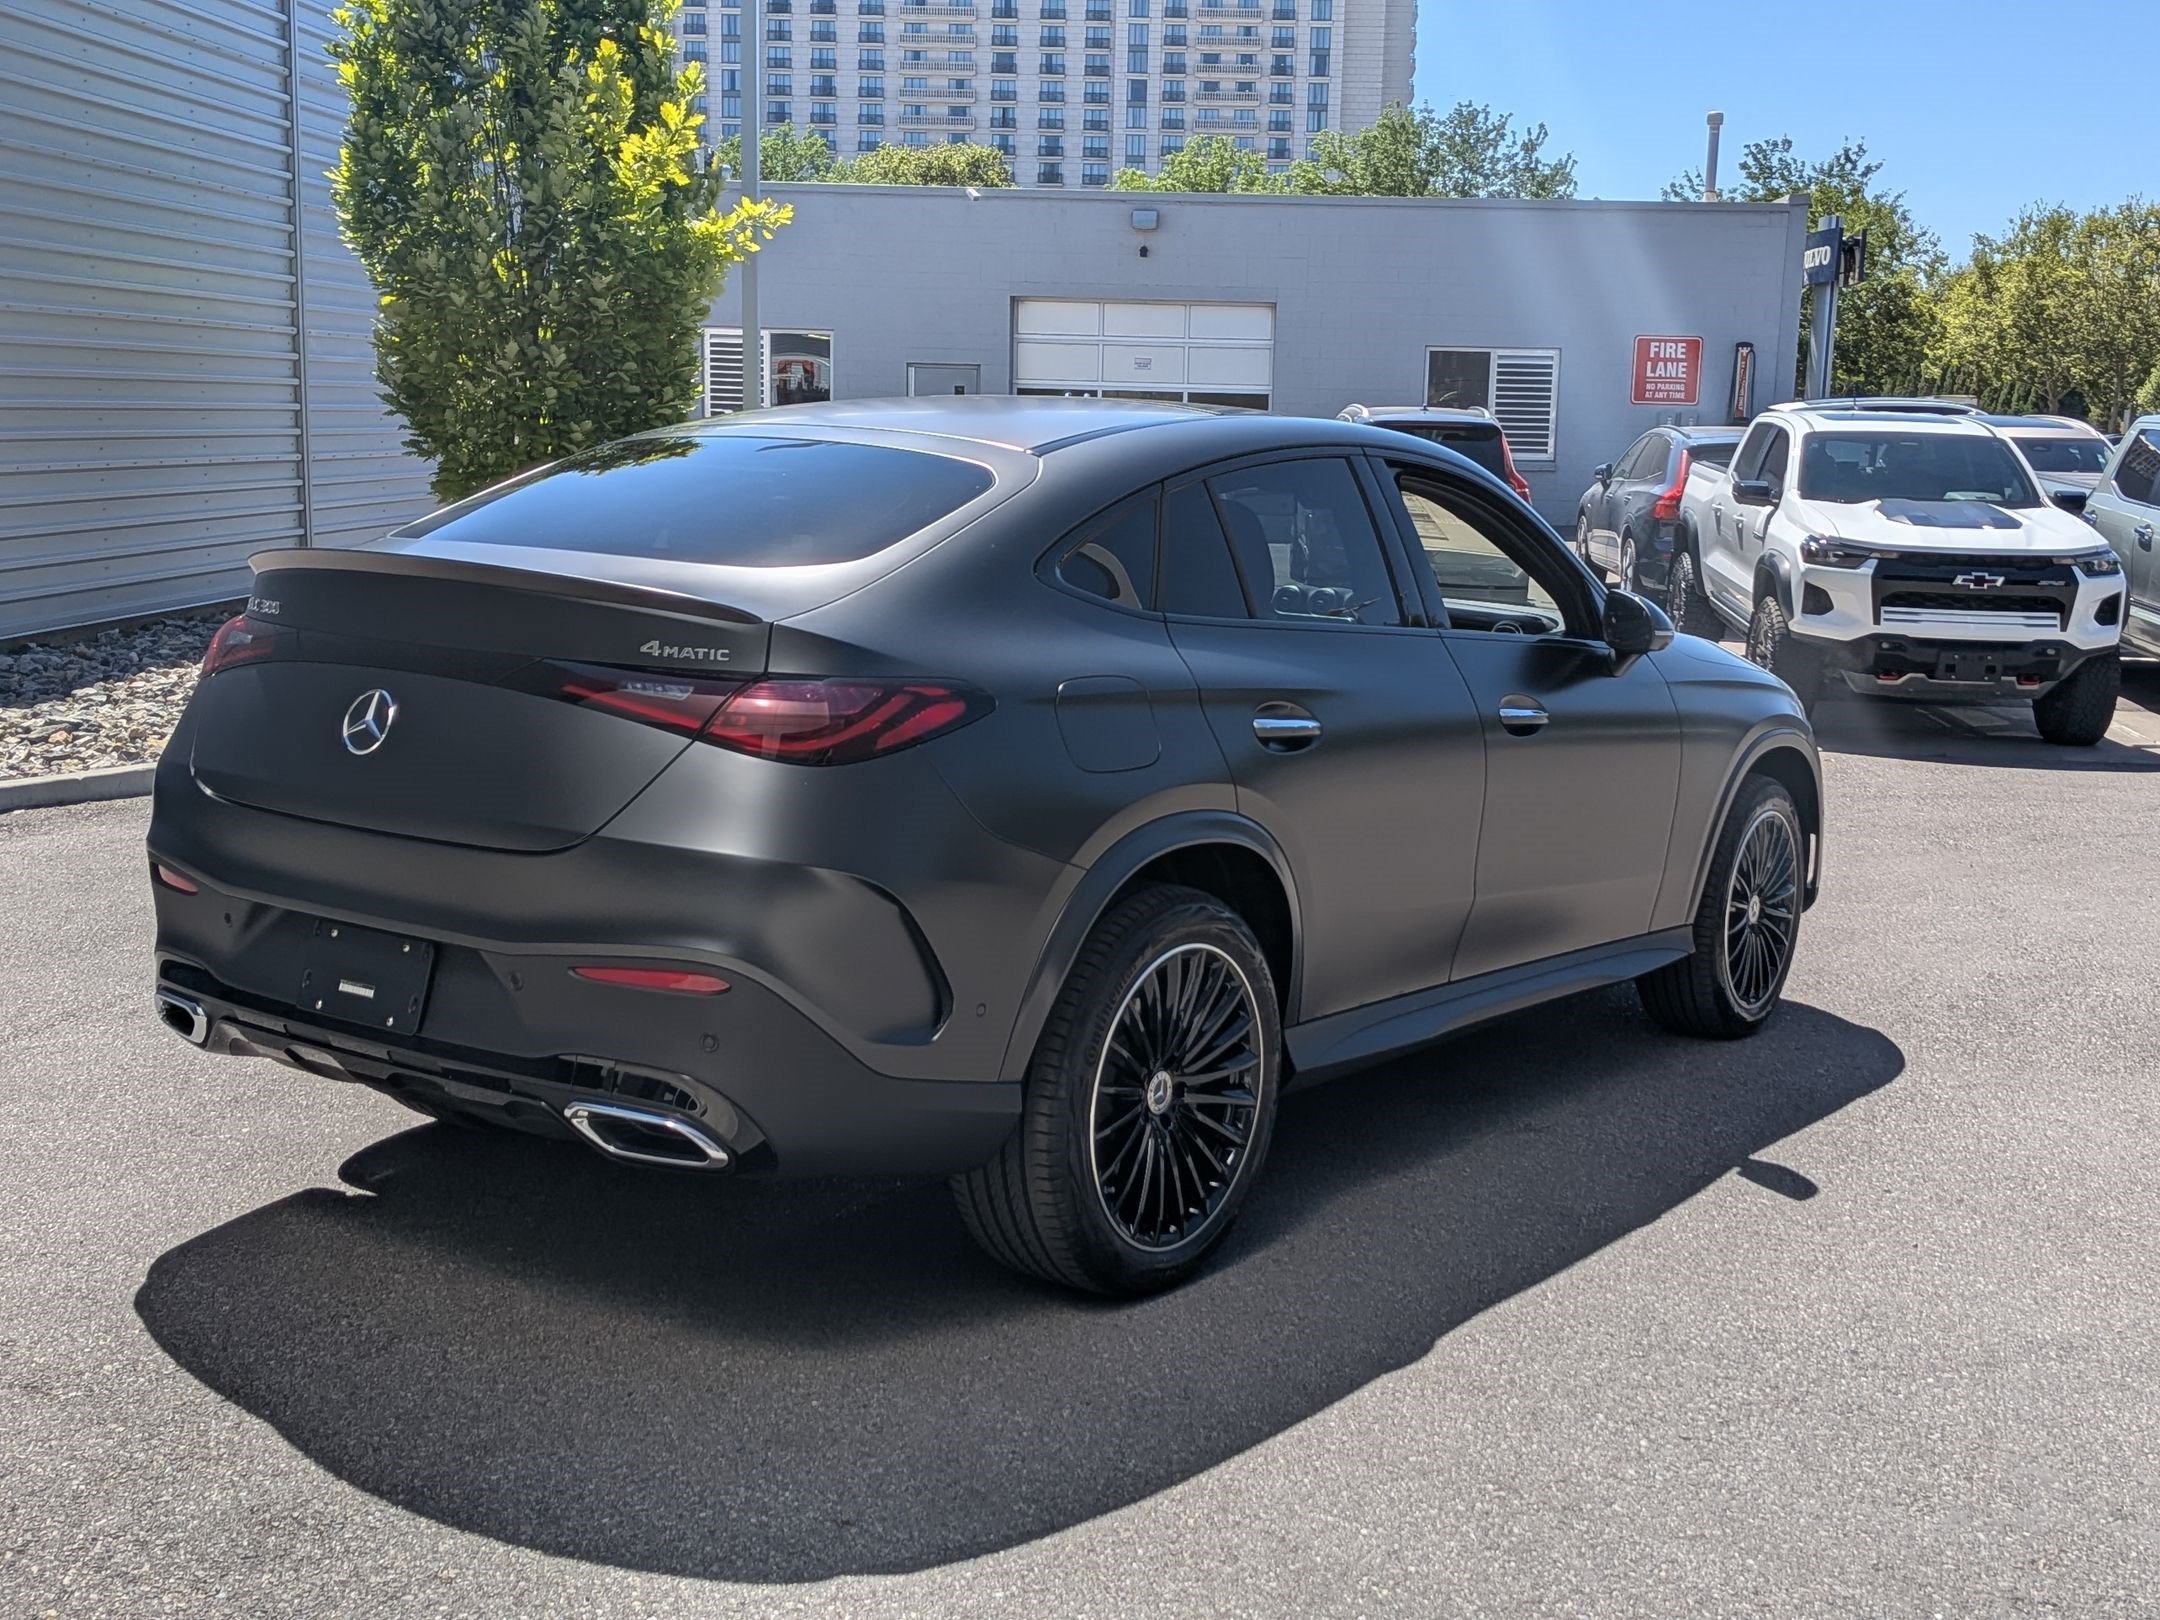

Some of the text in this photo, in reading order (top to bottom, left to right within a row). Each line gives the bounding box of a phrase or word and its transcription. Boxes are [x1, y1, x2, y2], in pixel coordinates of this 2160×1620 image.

[1650, 342, 1687, 358] FIRE
[1646, 362, 1687, 378] LANE
[1654, 391, 1668, 399] ANY
[1669, 391, 1686, 399] TIME
[1657, 383, 1685, 391] PARKING
[639, 640, 730, 661] 4MATIC
